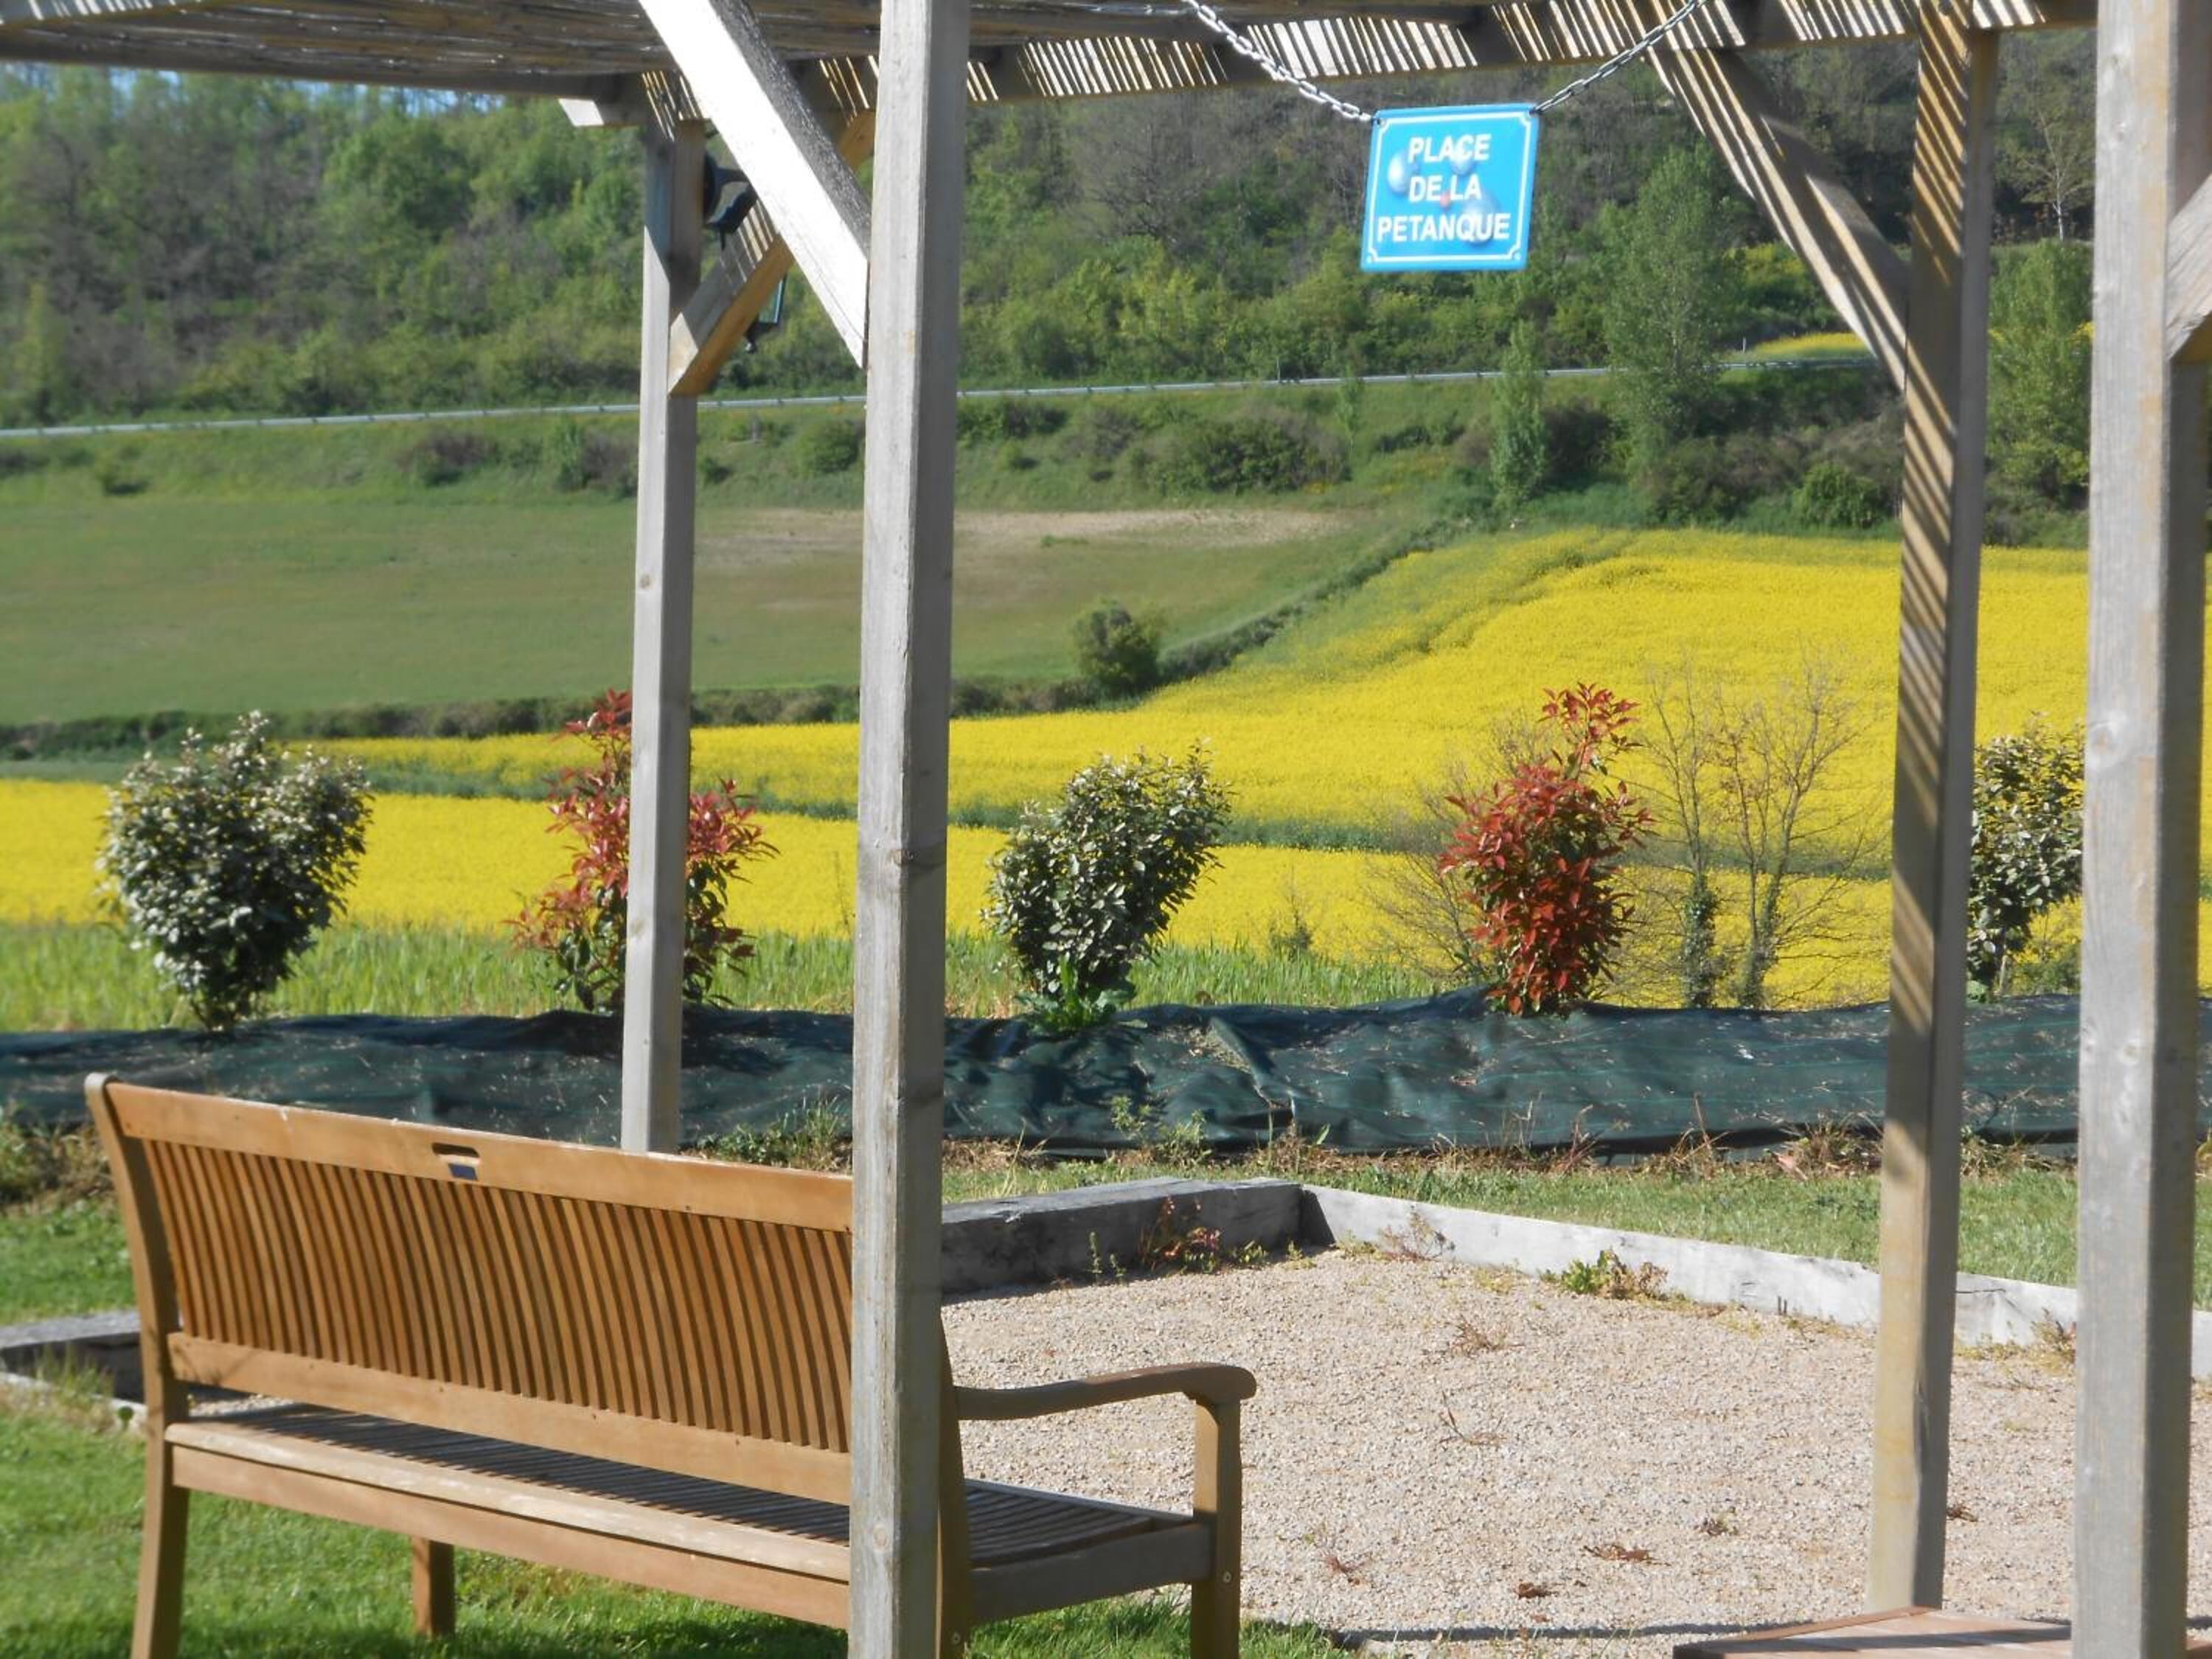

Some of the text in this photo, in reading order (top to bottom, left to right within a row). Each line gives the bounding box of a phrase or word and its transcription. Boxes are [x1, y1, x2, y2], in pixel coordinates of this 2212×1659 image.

[1408, 134, 1491, 163] PLACE
[1409, 174, 1481, 202] DE LA
[1377, 213, 1510, 243] PETANQUE
